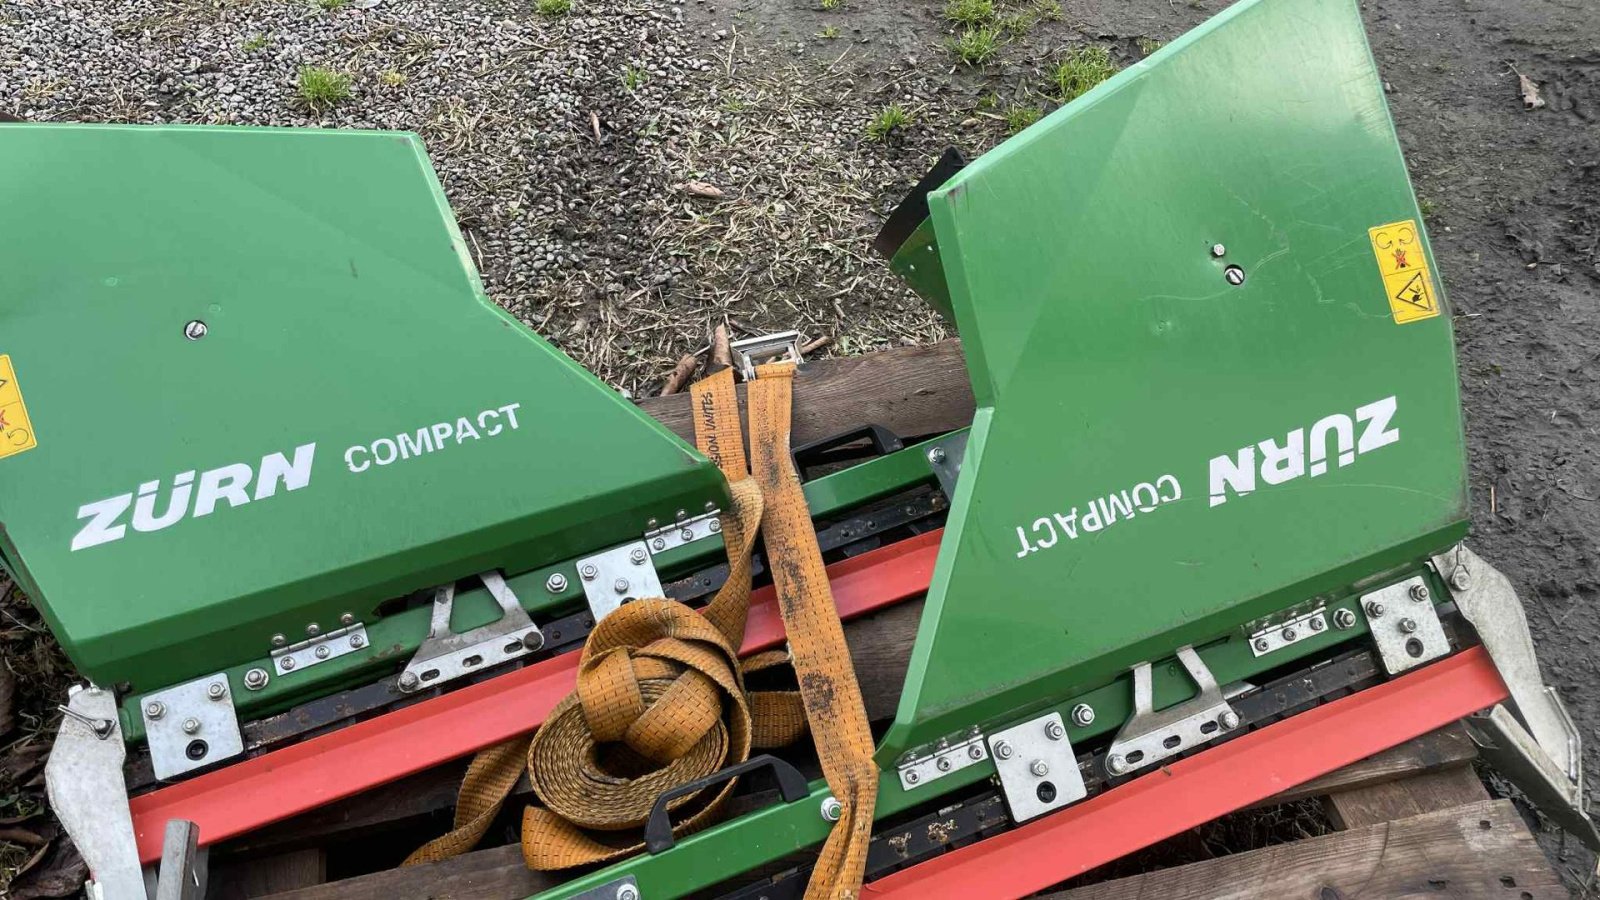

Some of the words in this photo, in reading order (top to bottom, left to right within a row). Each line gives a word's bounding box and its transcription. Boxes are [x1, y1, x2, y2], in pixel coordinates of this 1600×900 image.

[69, 442, 316, 551] ZÜRN
[343, 403, 521, 474] COMPACT
[1208, 395, 1400, 507] ZÜRN
[1016, 474, 1182, 558] COMPACT
